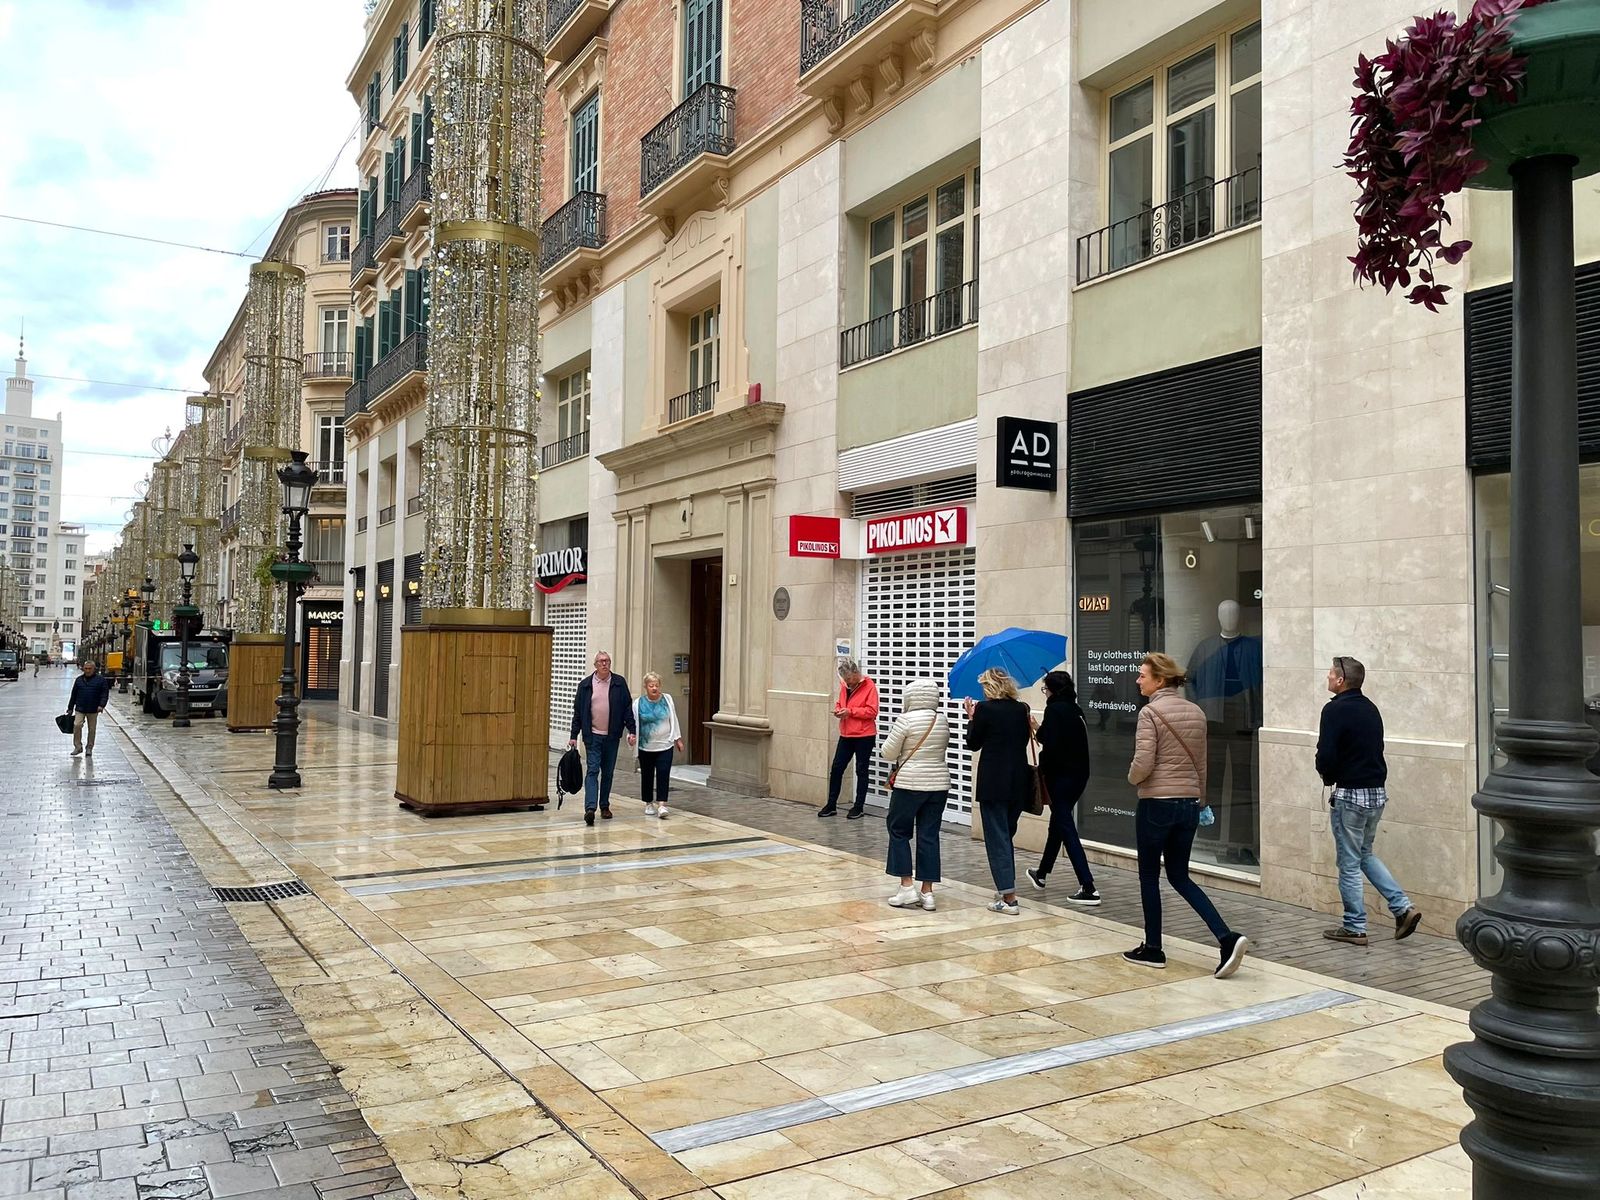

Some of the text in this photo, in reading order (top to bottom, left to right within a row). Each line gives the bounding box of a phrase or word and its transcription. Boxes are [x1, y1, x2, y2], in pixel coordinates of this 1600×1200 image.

[1010, 430, 1050, 457] AD
[868, 515, 933, 550] PIKOLINOS
[799, 542, 828, 552] PIKOLINOS
[534, 546, 584, 578] PRIMOR
[308, 611, 344, 620] MANGO
[1087, 650, 1101, 661] Buy
[1103, 650, 1132, 659] clothes
[1087, 662, 1141, 674] last longer tha
[1088, 676, 1114, 684] trends.
[1088, 700, 1137, 712] #sémásviejo
[1093, 805, 1136, 816] ADOLFODOMING
